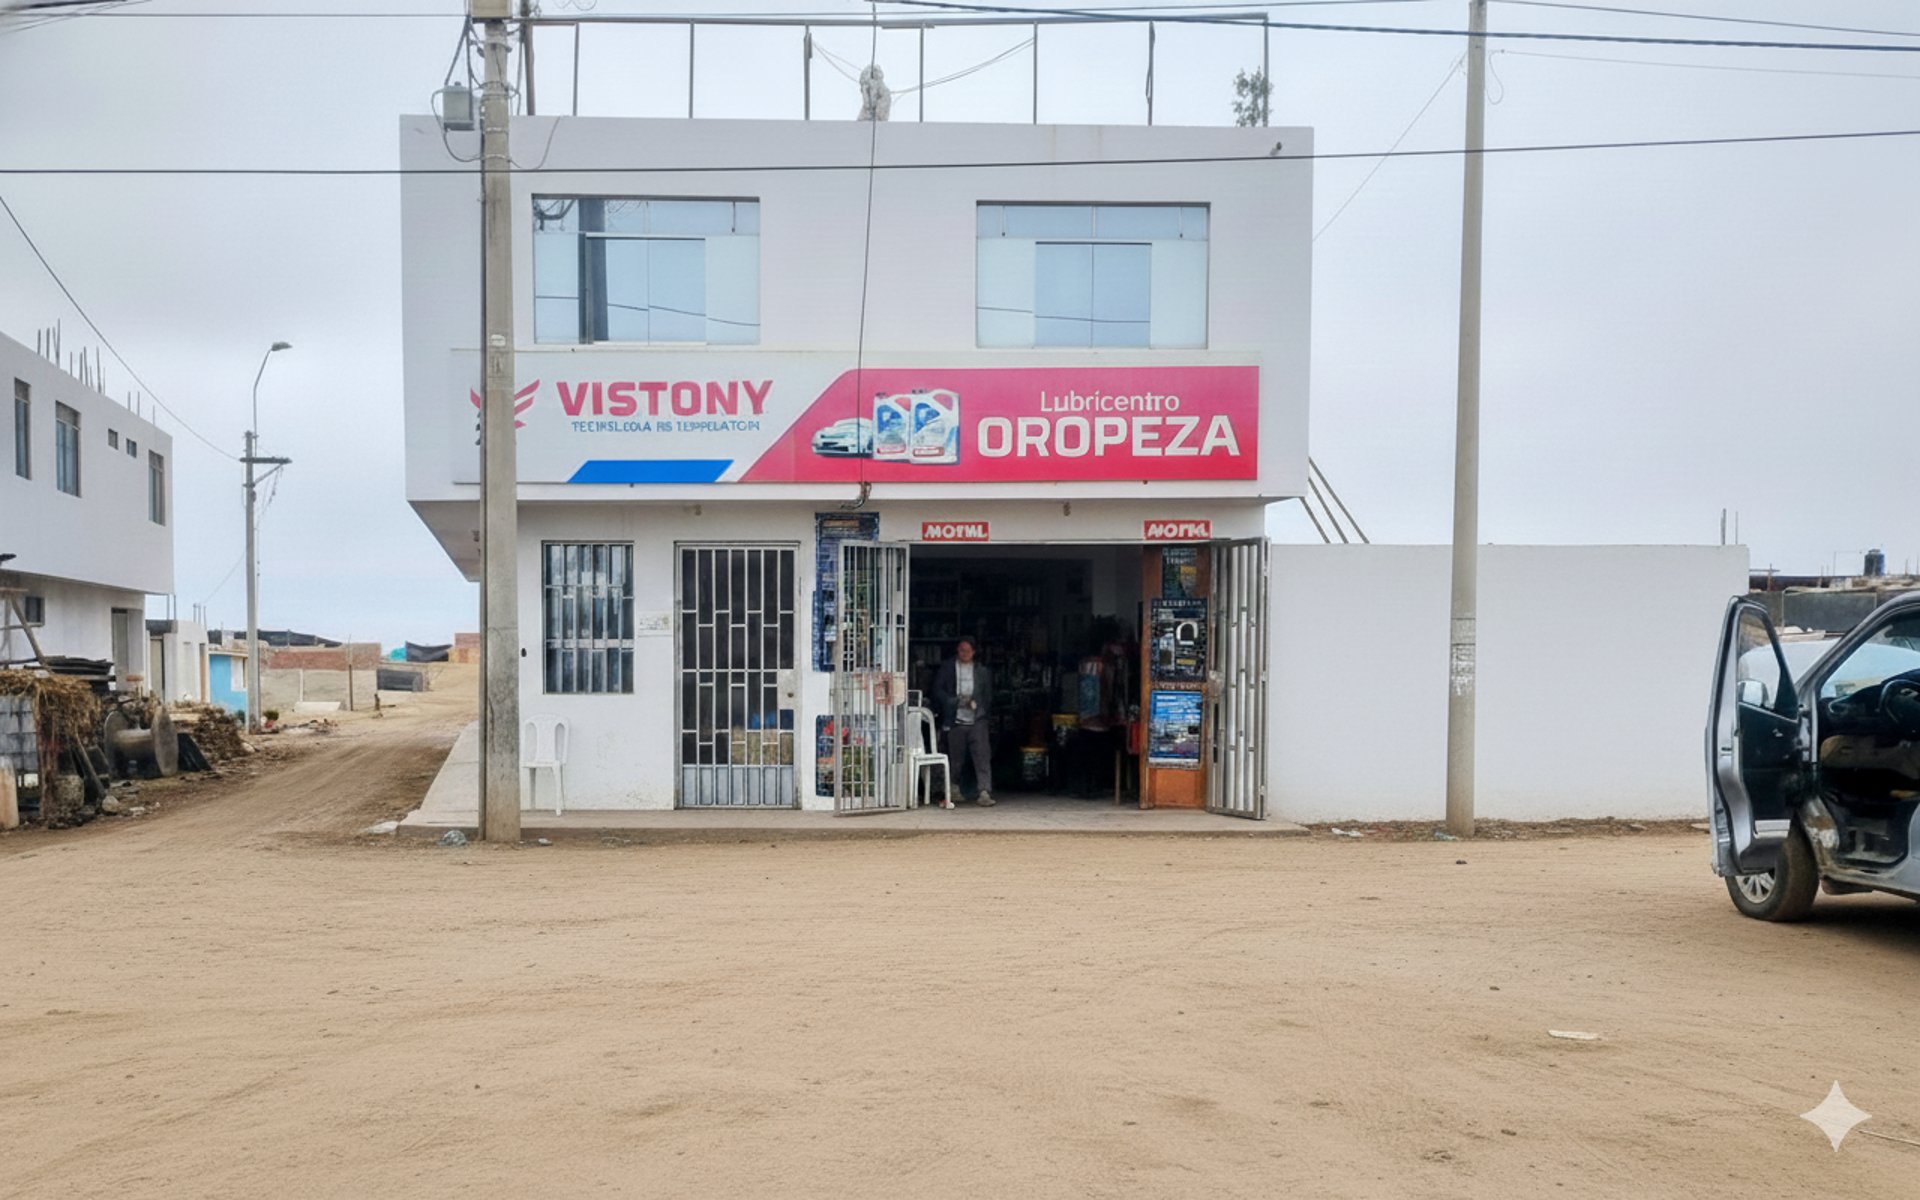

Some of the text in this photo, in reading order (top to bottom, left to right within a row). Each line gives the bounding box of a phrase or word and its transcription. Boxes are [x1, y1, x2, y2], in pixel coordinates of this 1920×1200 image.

[556, 380, 773, 416] VISTONY
[1040, 390, 1180, 412] Lubricentro
[977, 415, 1240, 457] OROPEZA
